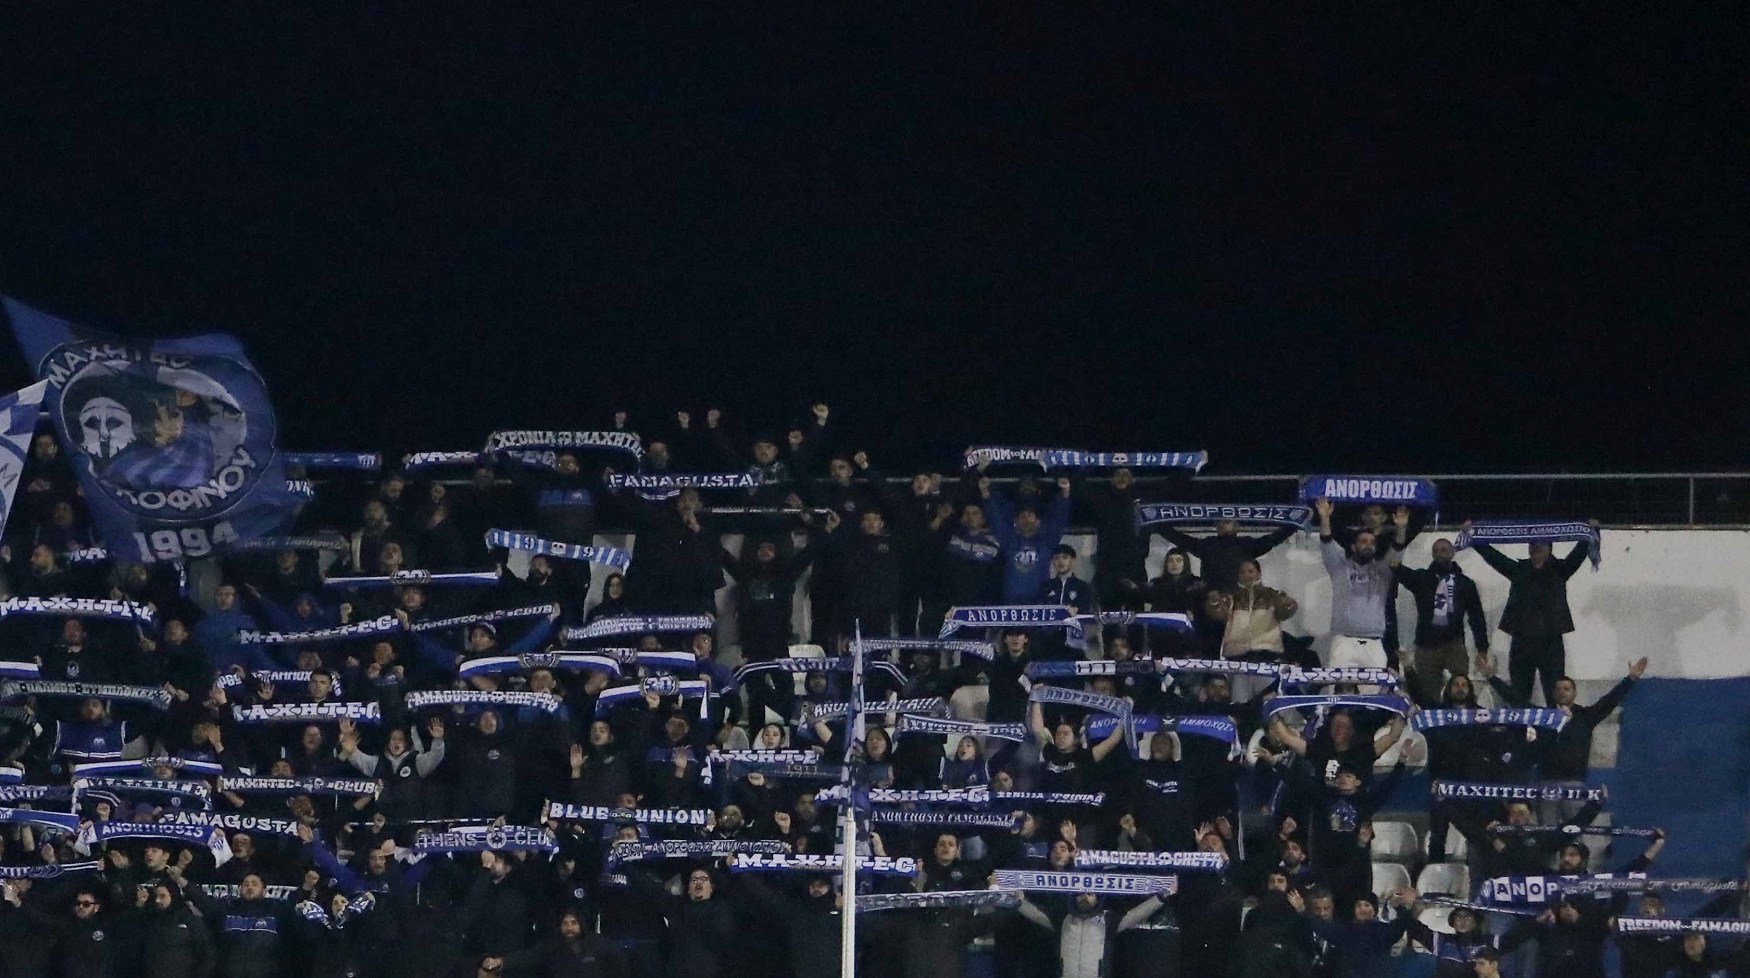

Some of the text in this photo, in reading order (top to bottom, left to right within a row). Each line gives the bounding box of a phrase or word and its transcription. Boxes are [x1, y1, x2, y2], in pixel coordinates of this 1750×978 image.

[1325, 479, 1419, 499] ΑΝΟΡΘΩΣΙΣ
[1161, 506, 1285, 520] ΑΝΟΡΘΩΣΙΣ
[133, 519, 240, 564] 1994
[967, 609, 1056, 622] ΑΝΟΡΘΩΣΙΣ
[550, 802, 706, 824] BLUE UNION
[1035, 874, 1135, 890] ΑΝΟΡΘΩΣΙΣ
[1618, 918, 1680, 932] FREEDOM
